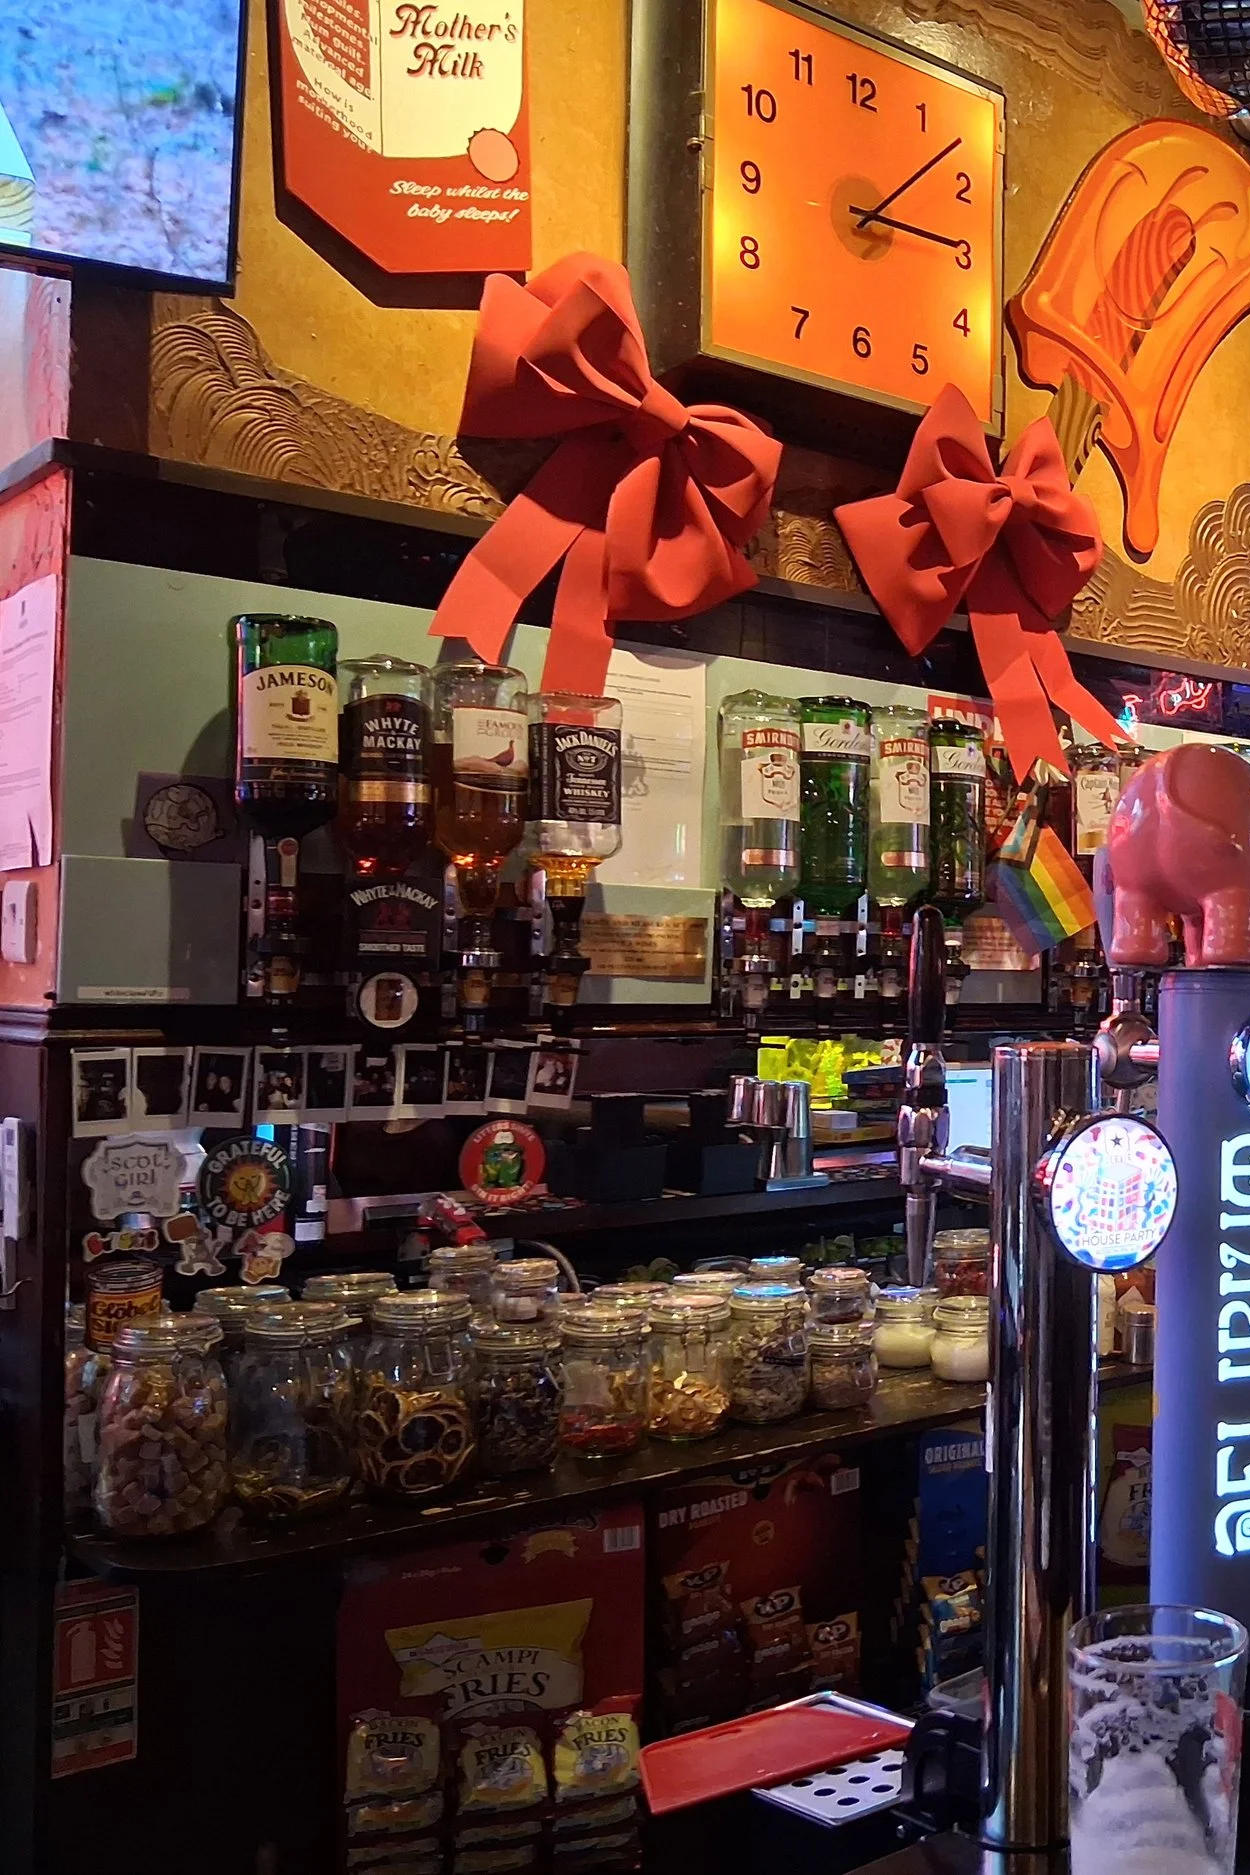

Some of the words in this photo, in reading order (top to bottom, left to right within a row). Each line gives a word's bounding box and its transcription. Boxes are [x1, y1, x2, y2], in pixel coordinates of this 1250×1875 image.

[389, 4, 519, 43] Mother's
[292, 35, 347, 79] maternal
[303, 29, 364, 78] Advanced
[407, 42, 485, 78] Milk
[788, 48, 813, 86] 11
[314, 77, 342, 102] How
[344, 98, 354, 113] is
[740, 83, 777, 123] 10
[845, 72, 878, 113] 12
[296, 79, 374, 141] motherhood
[298, 95, 340, 132] suiting
[915, 102, 927, 133] 1
[389, 180, 442, 199] Sleep
[446, 184, 502, 201] whilst
[502, 186, 529, 201] the
[740, 160, 762, 195] 9
[955, 171, 972, 204] 2
[407, 203, 453, 224] baby
[454, 207, 521, 224] sleeps!
[739, 235, 761, 270] 8
[955, 239, 972, 270] 3
[790, 305, 810, 340] 7
[952, 308, 971, 338] 4
[852, 326, 872, 359] 6
[911, 343, 930, 375] 5
[256, 671, 334, 696] JAMESON
[364, 717, 420, 735] WHYTE
[362, 735, 422, 751] MACKAY
[555, 734, 580, 753] JACK
[580, 731, 618, 758] DANIEL'S
[563, 788, 610, 798] WHISKEY
[350, 884, 388, 907] WHYTE
[395, 881, 440, 910] MACKAY
[207, 1139, 288, 1175] GRATEFUL
[207, 1196, 228, 1218] TO
[226, 1211, 248, 1227] BE
[251, 1189, 292, 1226] HERE
[1082, 1232, 1121, 1247] HOUSE
[1124, 1228, 1157, 1242] PARTY
[658, 1506, 687, 1529] DRY
[689, 1490, 748, 1521] ROASTED
[686, 1567, 721, 1588] KP
[757, 1593, 792, 1615] KP
[816, 1623, 848, 1642] KP
[443, 1649, 540, 1679] SCAMPI
[439, 1671, 551, 1712] FRIES
[364, 1731, 426, 1750] FRIES
[572, 1726, 630, 1750] FRIES
[473, 1742, 532, 1767] FRIES
